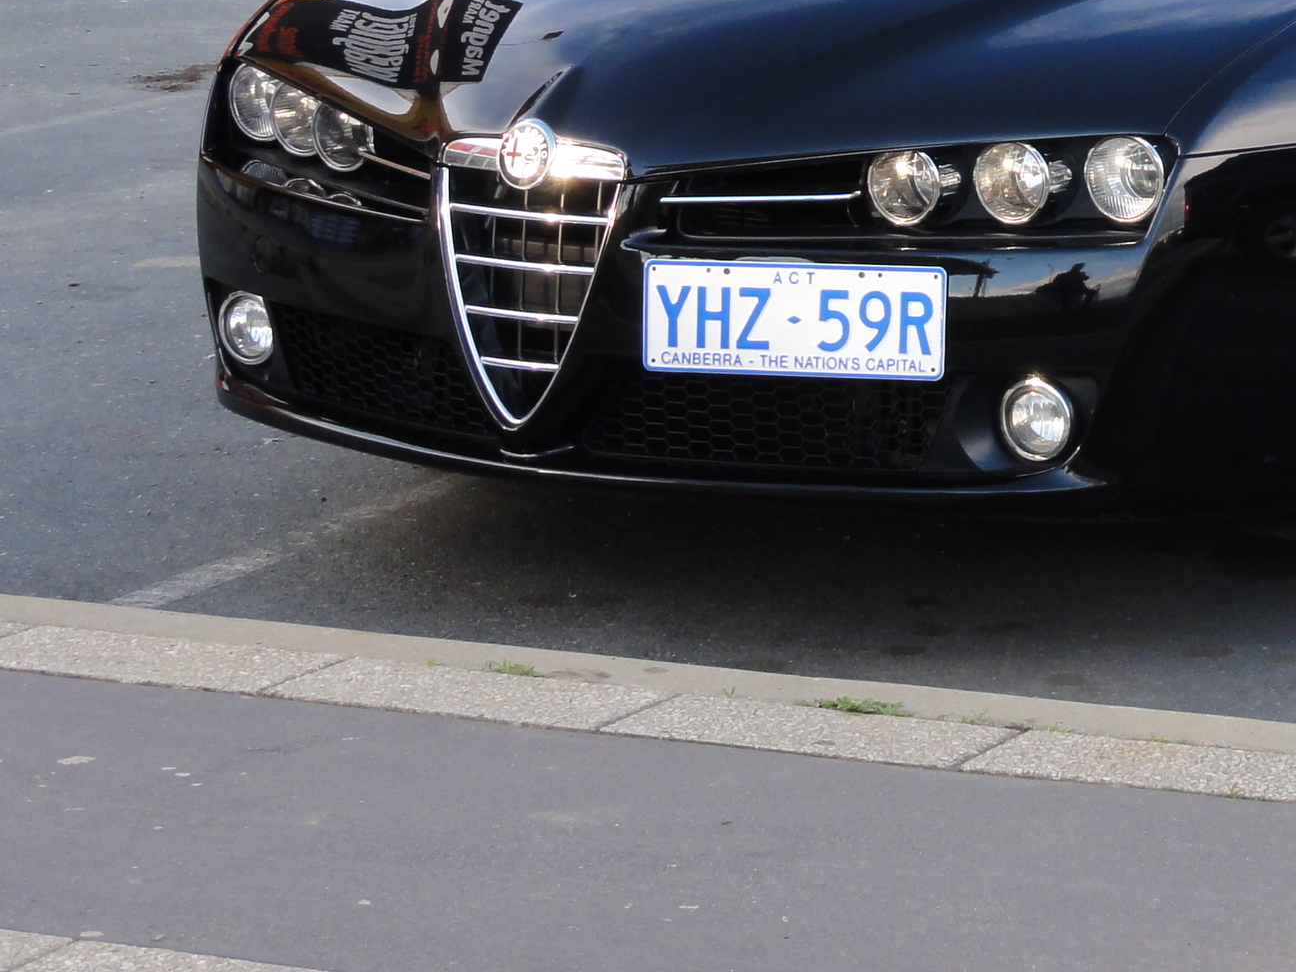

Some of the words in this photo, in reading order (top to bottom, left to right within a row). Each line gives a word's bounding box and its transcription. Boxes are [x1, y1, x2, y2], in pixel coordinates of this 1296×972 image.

[773, 271, 816, 285] ACT
[656, 284, 772, 350] YHZ
[817, 289, 934, 356] 59R
[660, 351, 743, 367] CANBERRA
[760, 354, 788, 368] THE
[793, 355, 862, 371] NATION'S
[865, 358, 926, 373] CAPITAL
